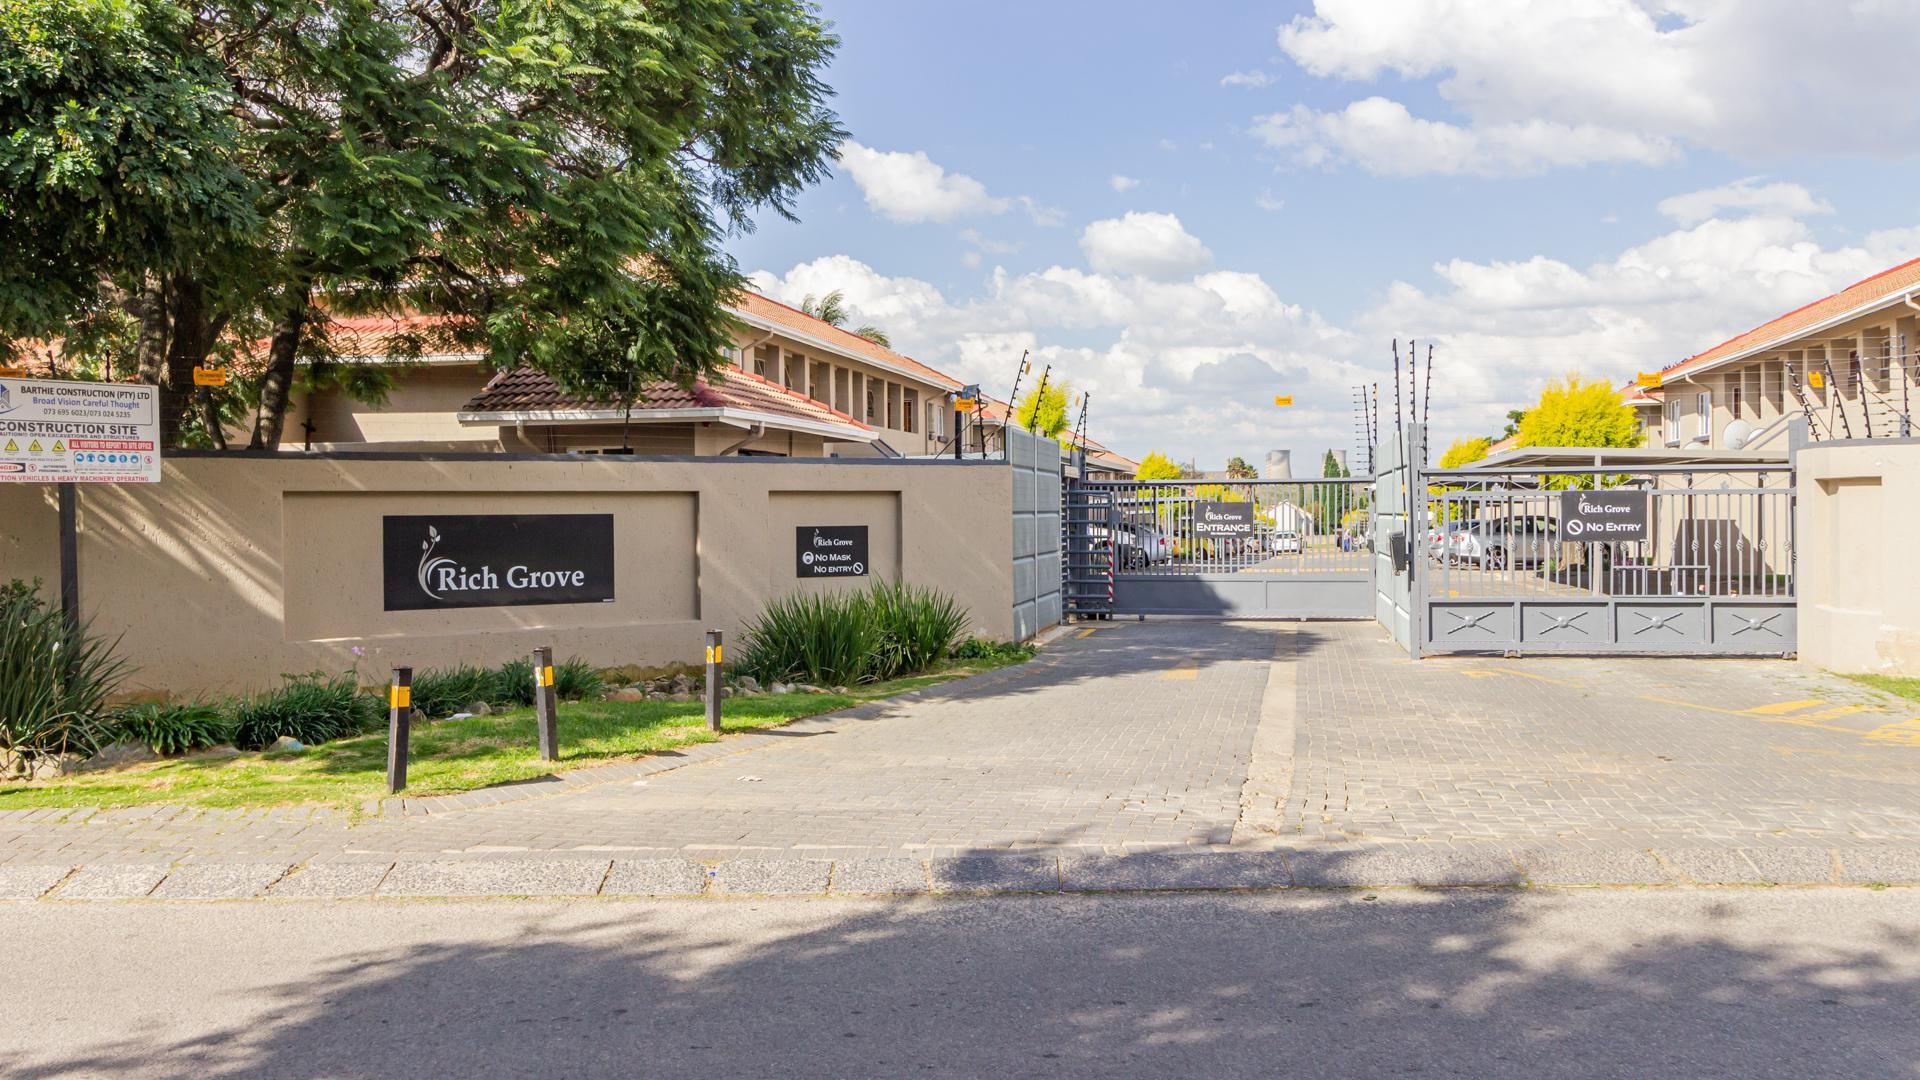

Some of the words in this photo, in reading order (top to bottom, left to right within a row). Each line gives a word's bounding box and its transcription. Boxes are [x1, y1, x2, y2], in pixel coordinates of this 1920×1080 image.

[21, 385, 54, 395] BARTHIE
[56, 387, 116, 398] CONSTRUCTION
[117, 390, 136, 400] (PTY)
[137, 391, 150, 400] LTD
[32, 397, 56, 405] Broad
[58, 397, 81, 406] Vision
[82, 399, 109, 407] Careful
[110, 400, 140, 410] Thought
[0, 421, 105, 434] CONSTRUCTION
[109, 425, 138, 435] SITE
[1584, 505, 1603, 513] Rich
[1604, 505, 1631, 513] Grove
[1196, 522, 1251, 532] ENTRANCE
[818, 538, 833, 546] Rich
[833, 538, 853, 546] Grove
[437, 565, 500, 592] Rich
[506, 565, 585, 589] Grove
